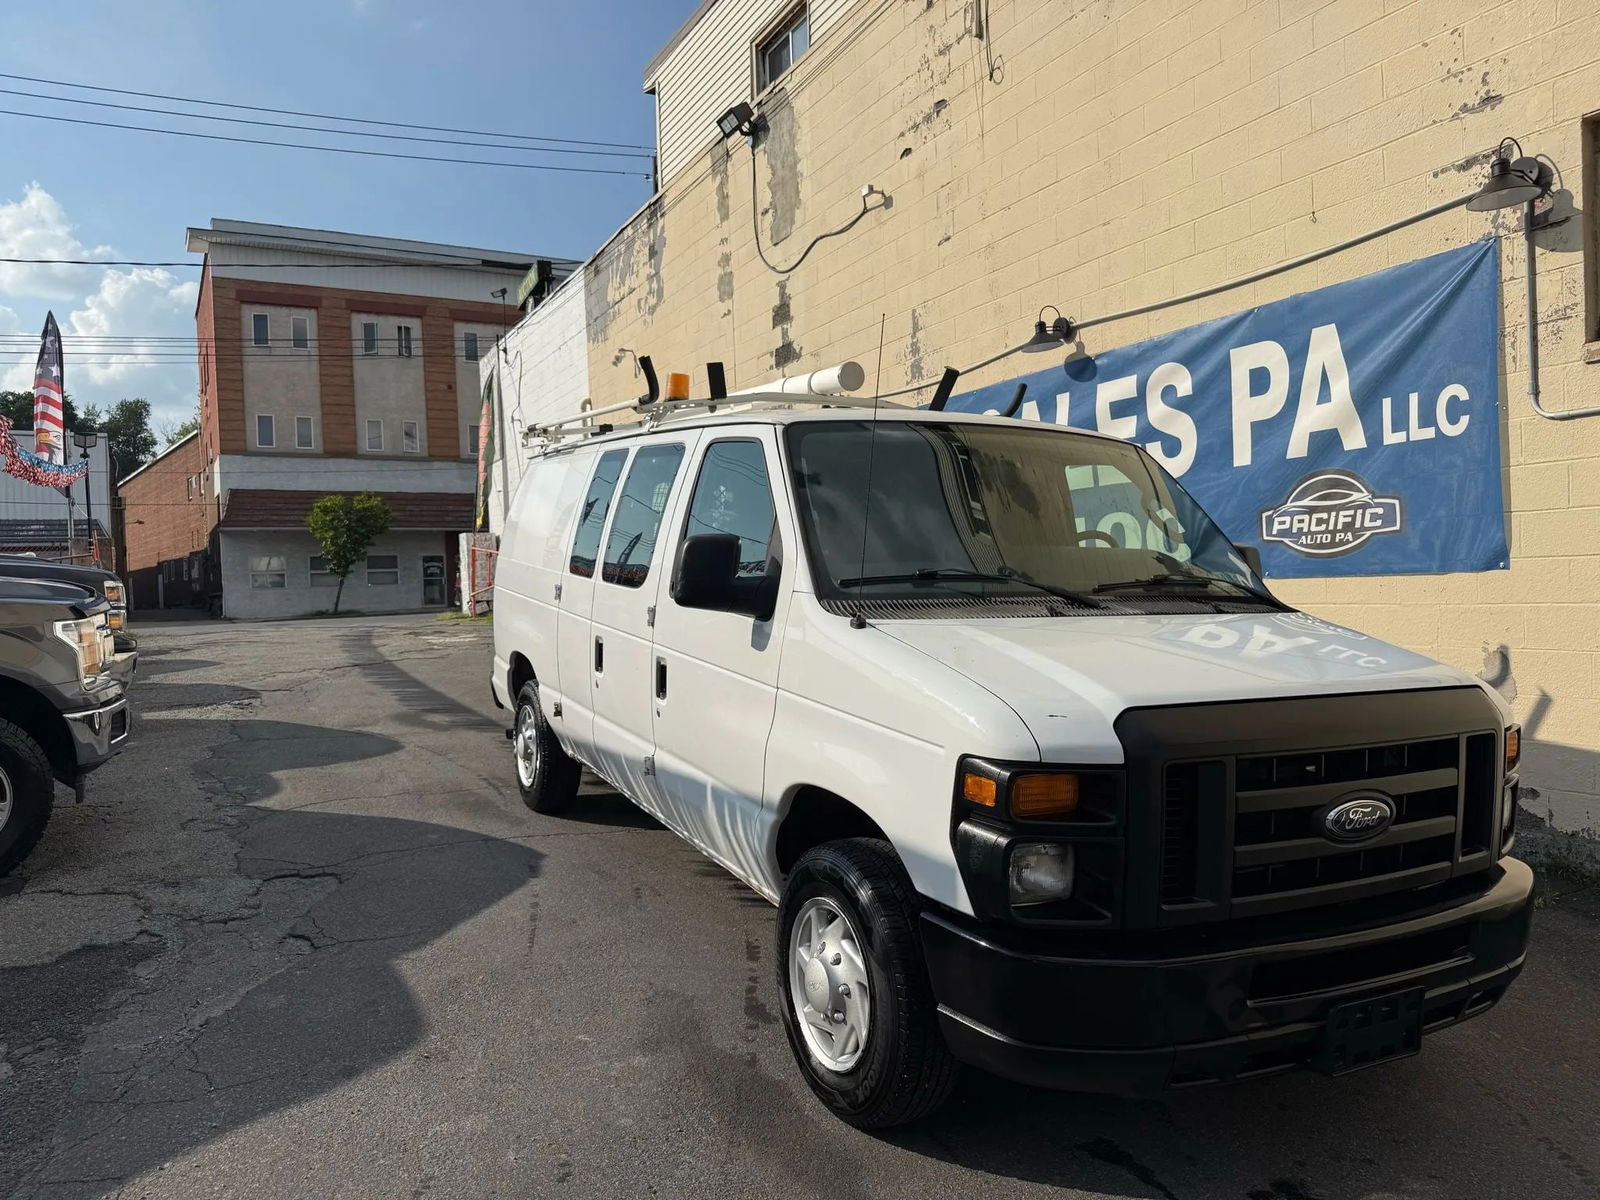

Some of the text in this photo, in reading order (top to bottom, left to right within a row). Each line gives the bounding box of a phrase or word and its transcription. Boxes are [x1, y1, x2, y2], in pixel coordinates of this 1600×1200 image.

[1229, 323, 1367, 467] PA
[1382, 384, 1470, 446] LLC
[1272, 507, 1384, 535] PACIFIC
[1298, 532, 1353, 545] AUTO PA
[1345, 807, 1380, 830] Ford
